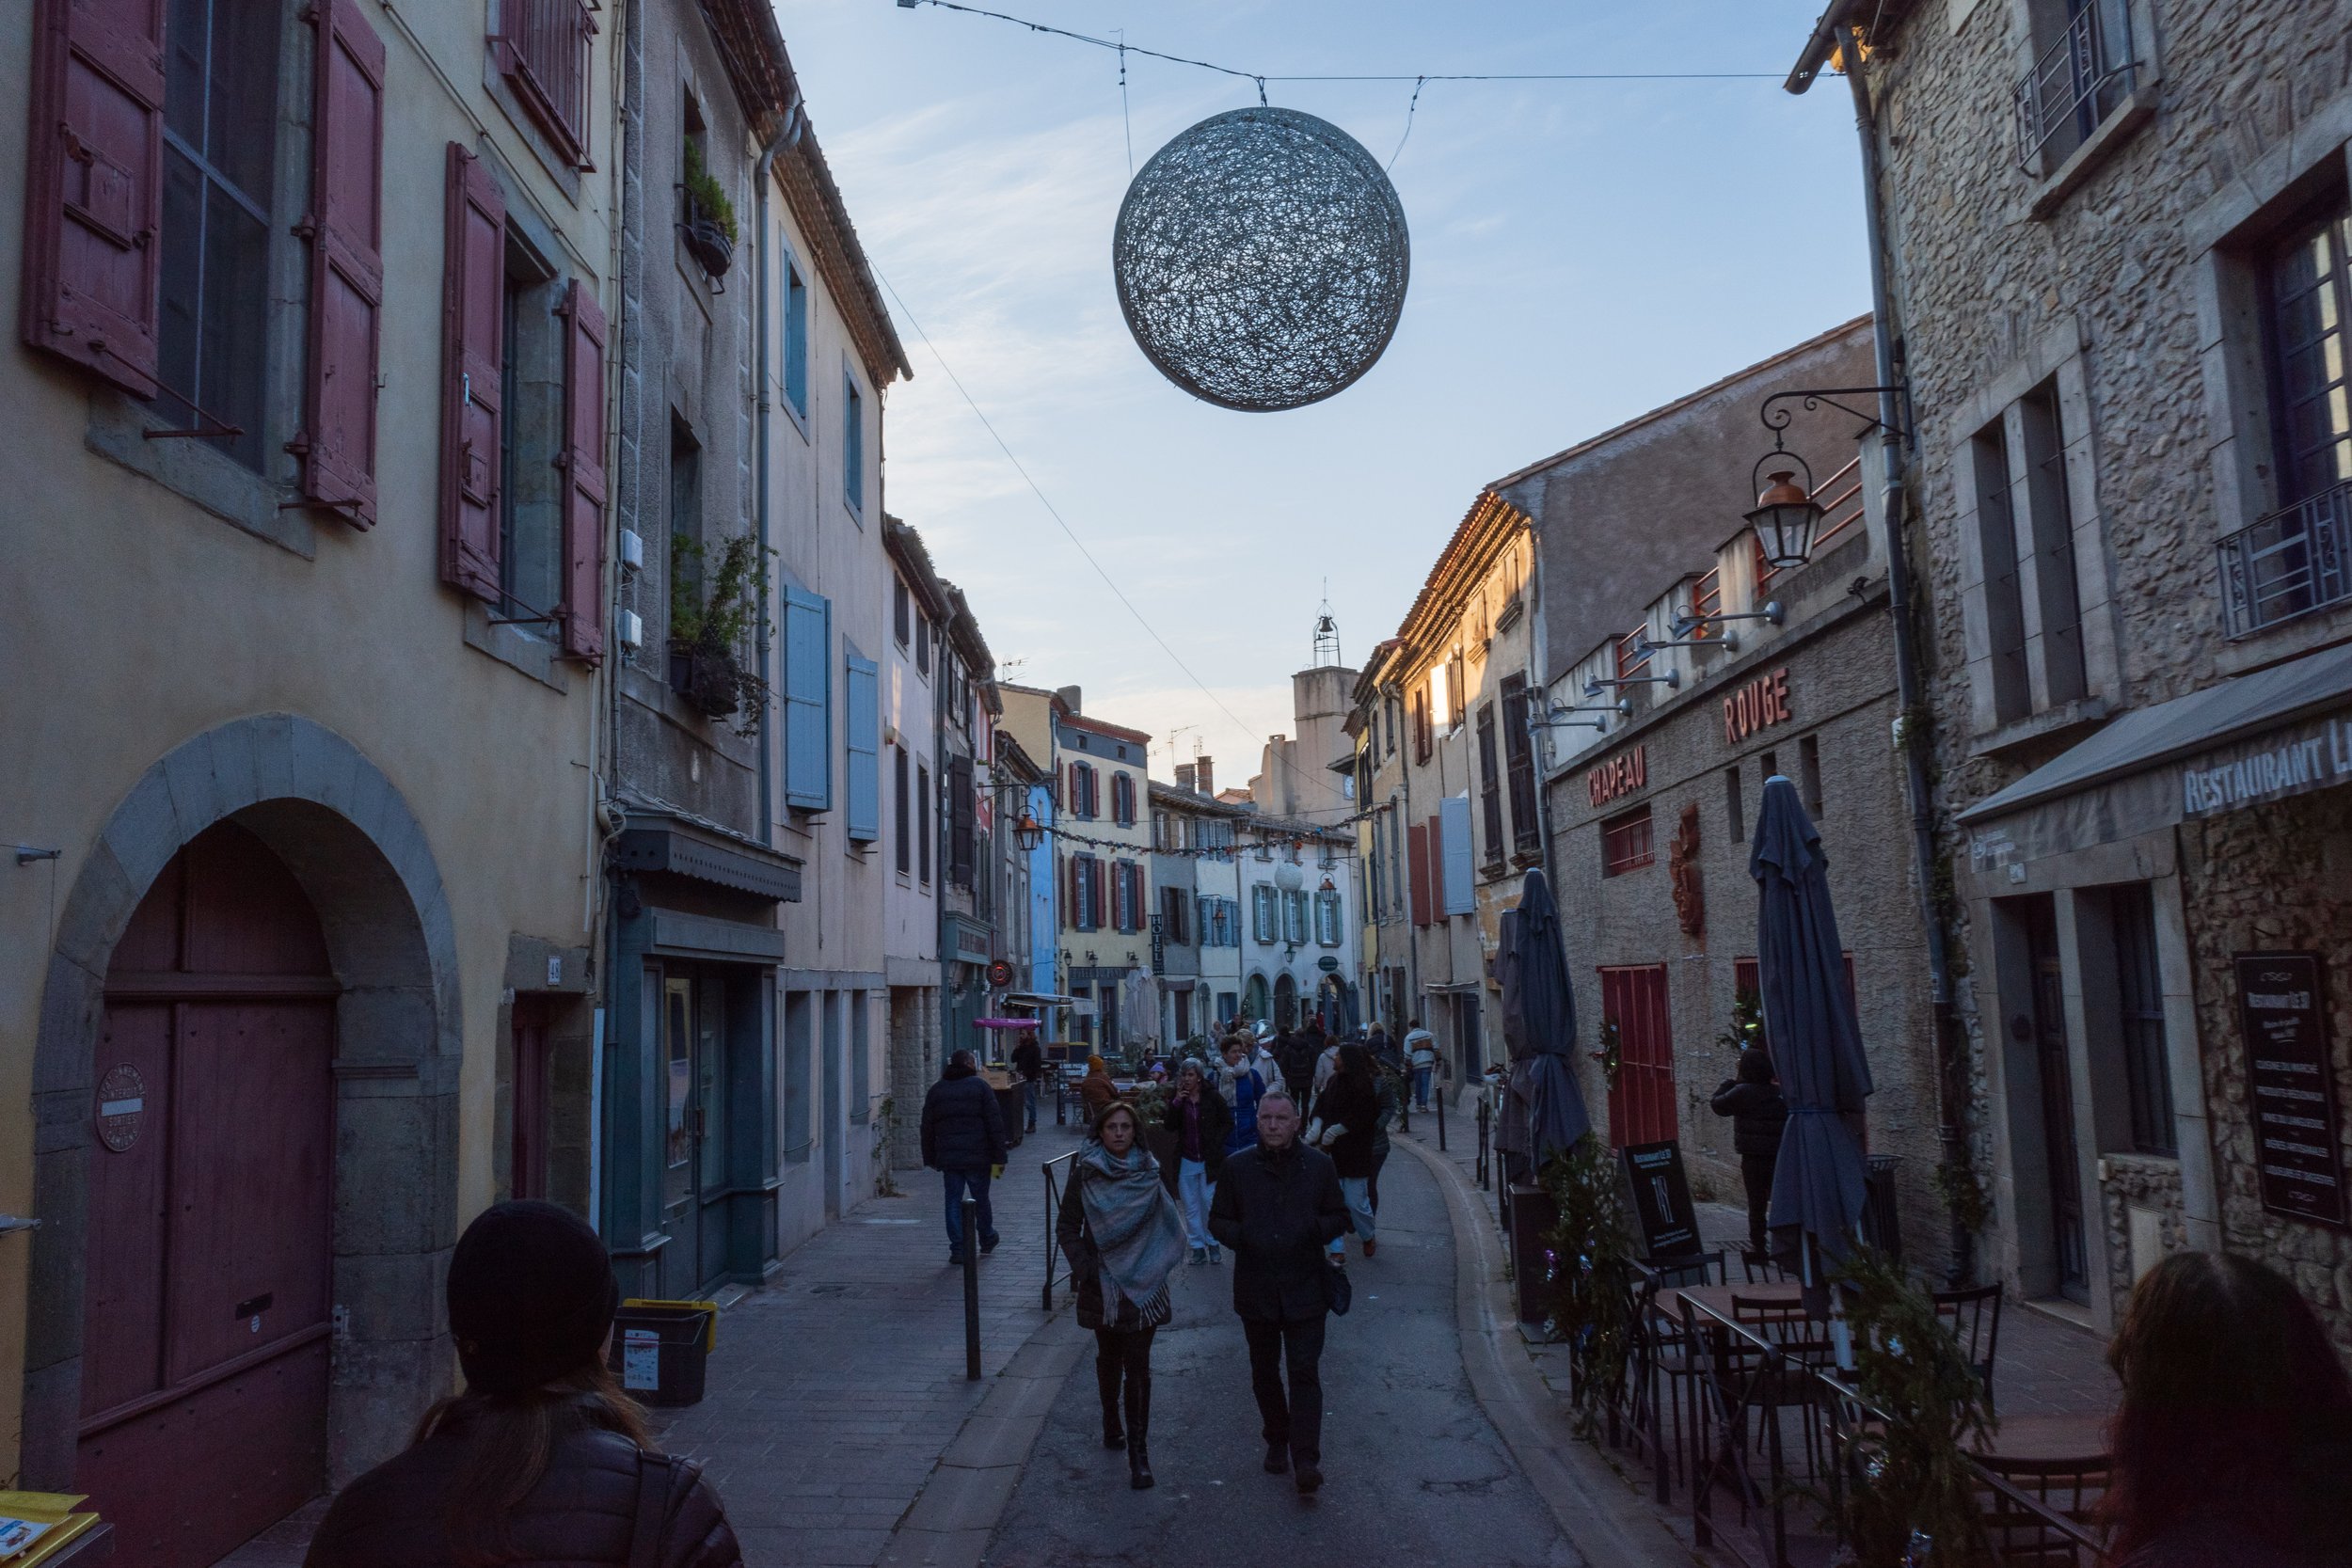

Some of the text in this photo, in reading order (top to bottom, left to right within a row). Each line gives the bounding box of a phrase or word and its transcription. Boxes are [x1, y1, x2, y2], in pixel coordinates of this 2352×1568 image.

[1724, 667, 1790, 744] ROUGE
[1587, 746, 1647, 807] CHAPEAU
[2185, 736, 2324, 814] RESTAURANT
[1152, 915, 1163, 961] HOTEL
[107, 1086, 137, 1099] INTERDIT
[105, 1129, 137, 1147] CAMIONS
[108, 1114, 136, 1127] SORTIES
